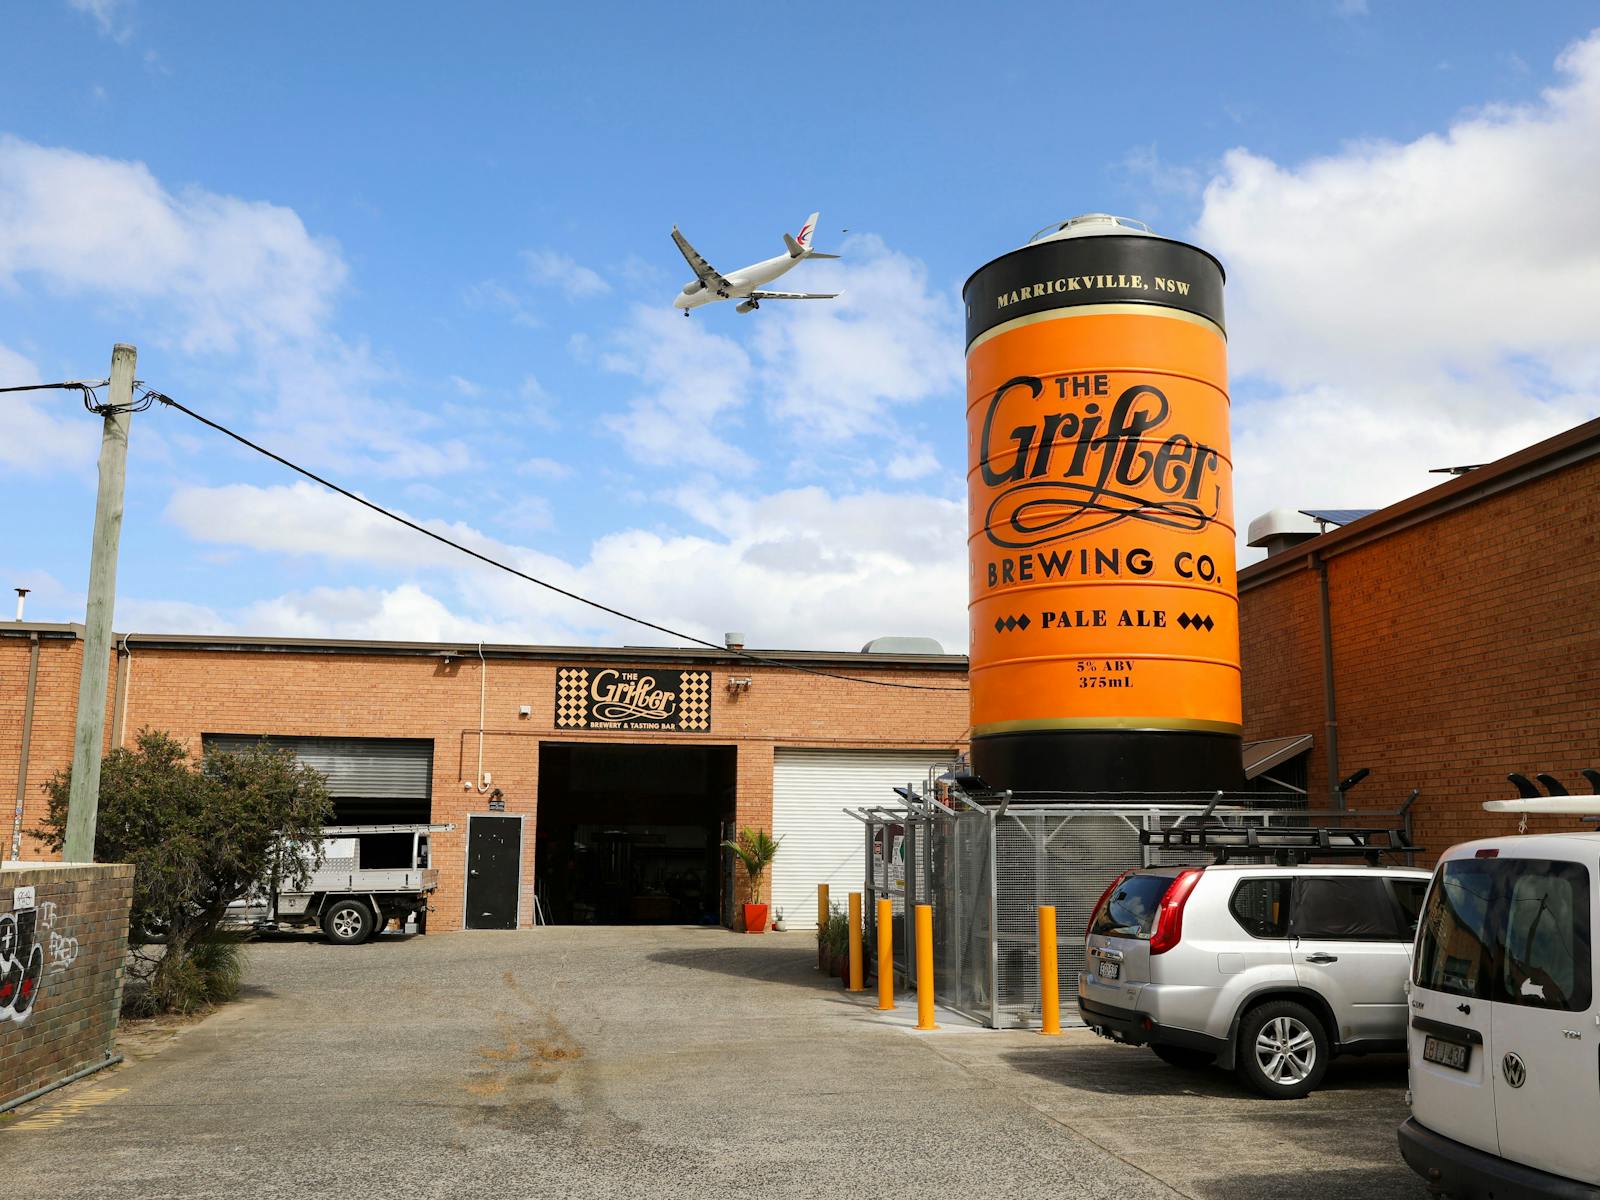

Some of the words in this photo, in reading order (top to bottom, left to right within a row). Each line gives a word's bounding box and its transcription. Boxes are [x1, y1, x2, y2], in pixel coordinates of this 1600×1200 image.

[997, 274, 1149, 309] MARRICKVILLE,
[1155, 277, 1191, 296] NSW
[1055, 374, 1110, 398] THE
[981, 376, 1220, 548] Grifter
[987, 548, 1154, 587] BREWING
[1174, 551, 1221, 584] CO.
[1041, 610, 1107, 629] PALE
[1118, 609, 1167, 628] ALE
[622, 672, 638, 681] THE
[1076, 660, 1097, 672] 5%
[1103, 660, 1135, 672] ABV
[1079, 676, 1134, 688] 375mL
[591, 669, 676, 721] Grifter
